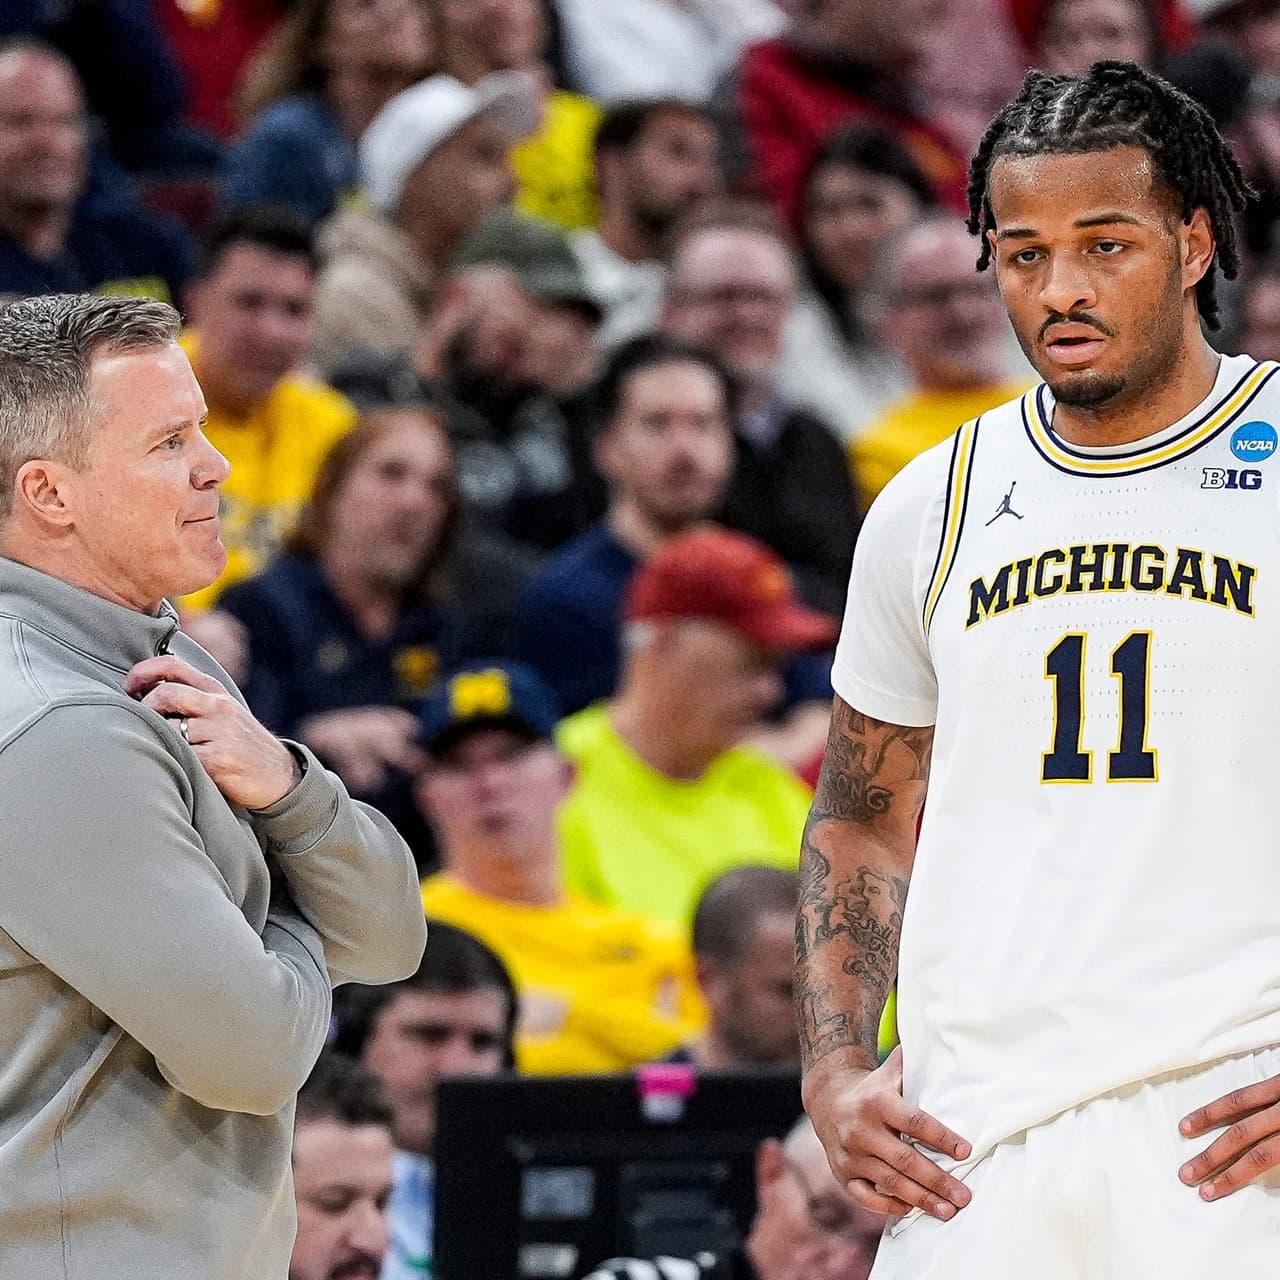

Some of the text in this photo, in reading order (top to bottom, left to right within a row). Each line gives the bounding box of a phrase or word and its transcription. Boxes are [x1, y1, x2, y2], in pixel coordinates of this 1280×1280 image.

[1235, 438, 1275, 452] NCAA
[964, 541, 1259, 632] MICHIGAN
[1039, 629, 1160, 785] 11
